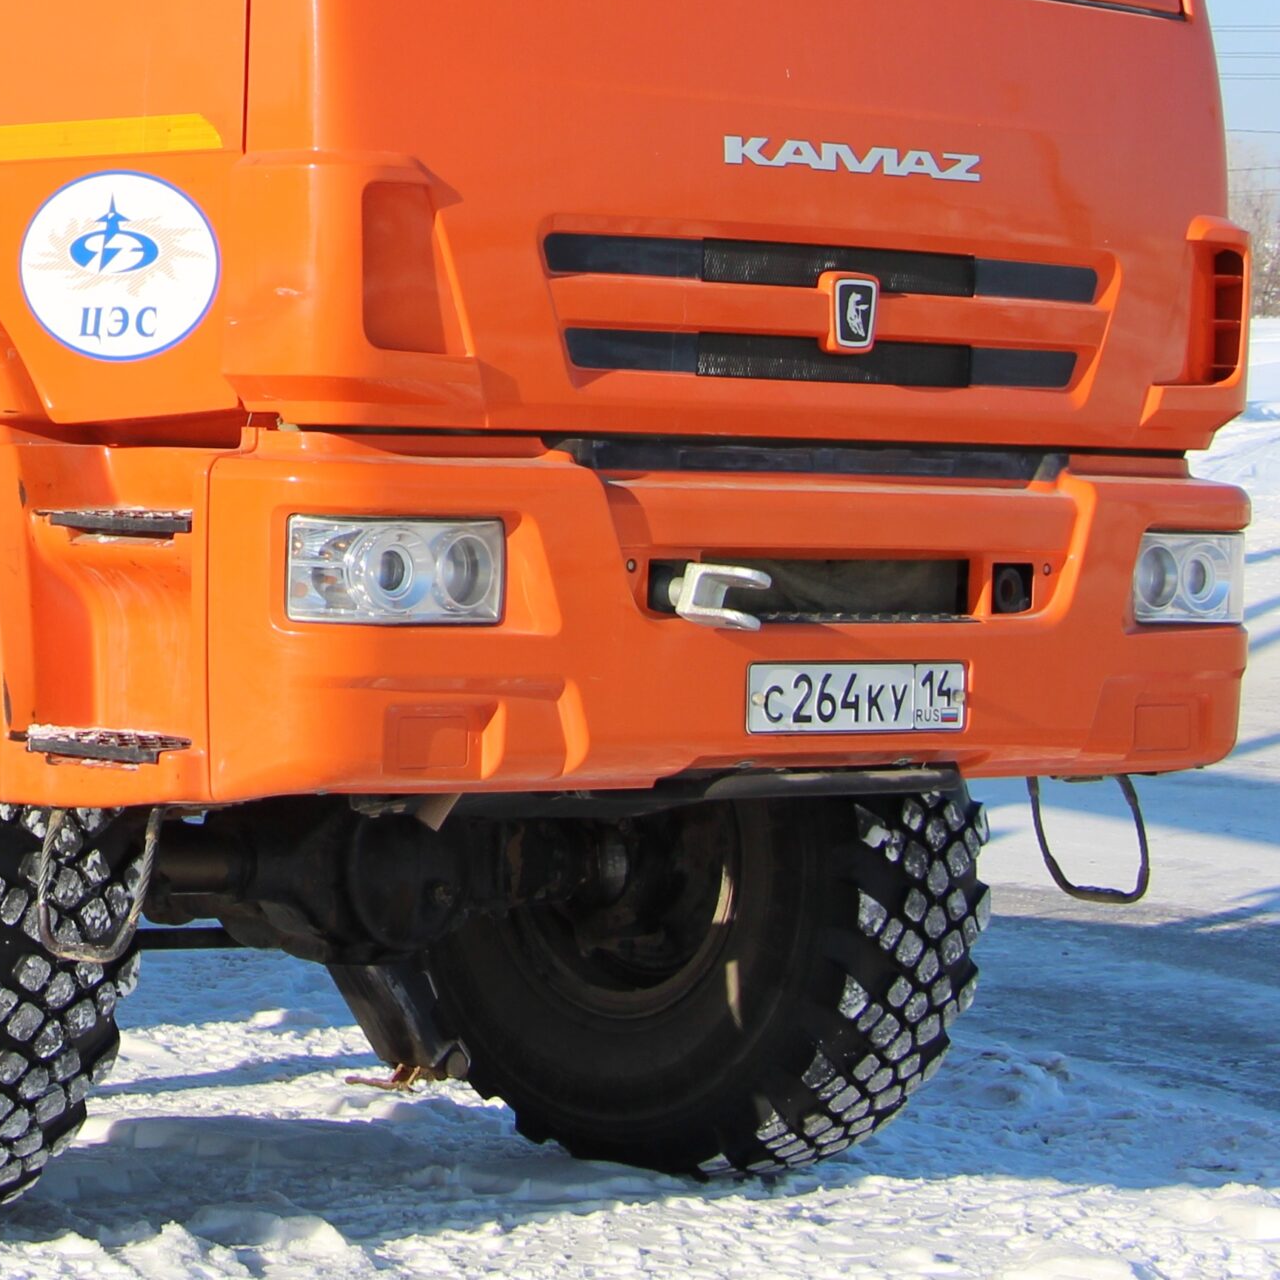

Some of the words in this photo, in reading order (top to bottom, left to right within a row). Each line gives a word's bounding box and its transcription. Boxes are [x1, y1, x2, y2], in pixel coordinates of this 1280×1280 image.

[723, 135, 981, 182] KAMAZ
[79, 306, 158, 345] ЦЭС
[921, 670, 952, 708] 14
[915, 708, 940, 722] RUS
